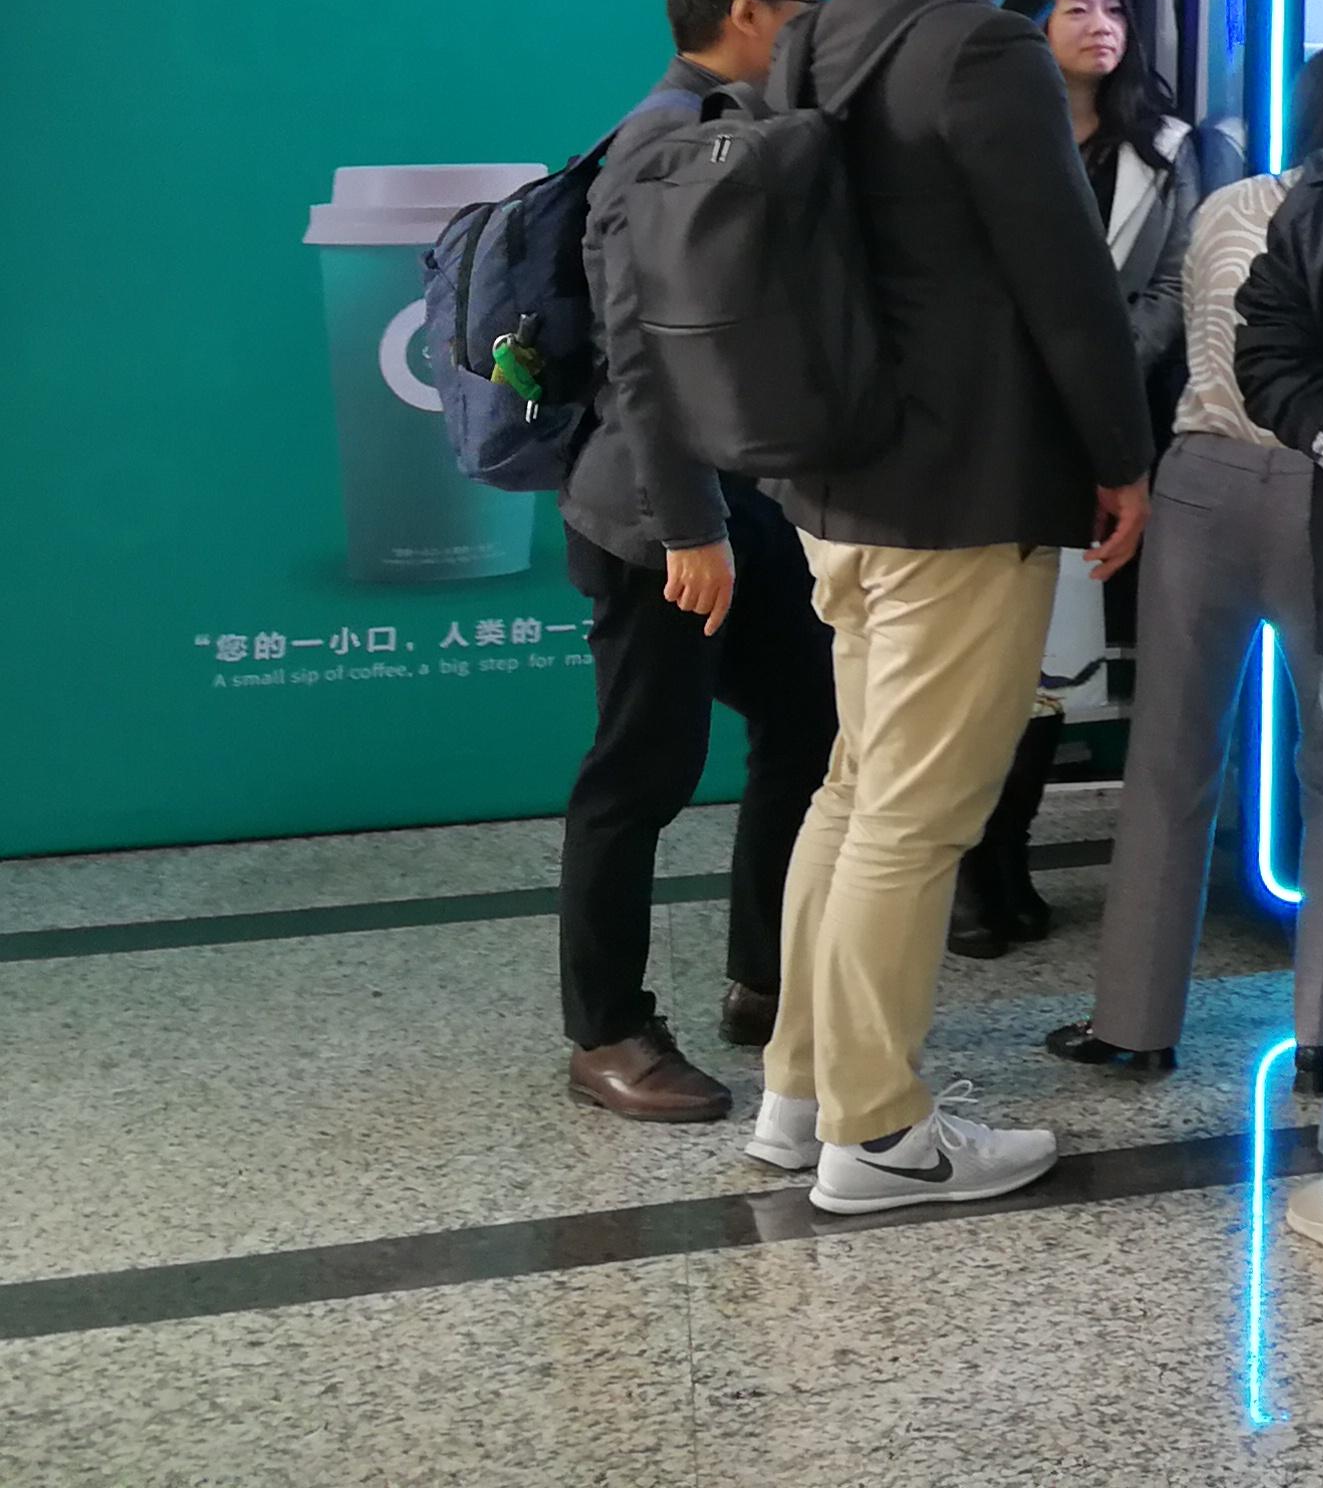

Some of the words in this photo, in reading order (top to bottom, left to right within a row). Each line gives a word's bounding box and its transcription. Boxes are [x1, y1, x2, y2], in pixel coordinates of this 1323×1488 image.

[213, 673, 228, 688] A
[231, 667, 285, 687] small
[290, 666, 320, 686] sip
[324, 663, 344, 680] of
[418, 664, 430, 676] a
[439, 656, 470, 678] big
[479, 654, 520, 676] step
[529, 652, 556, 669] for
